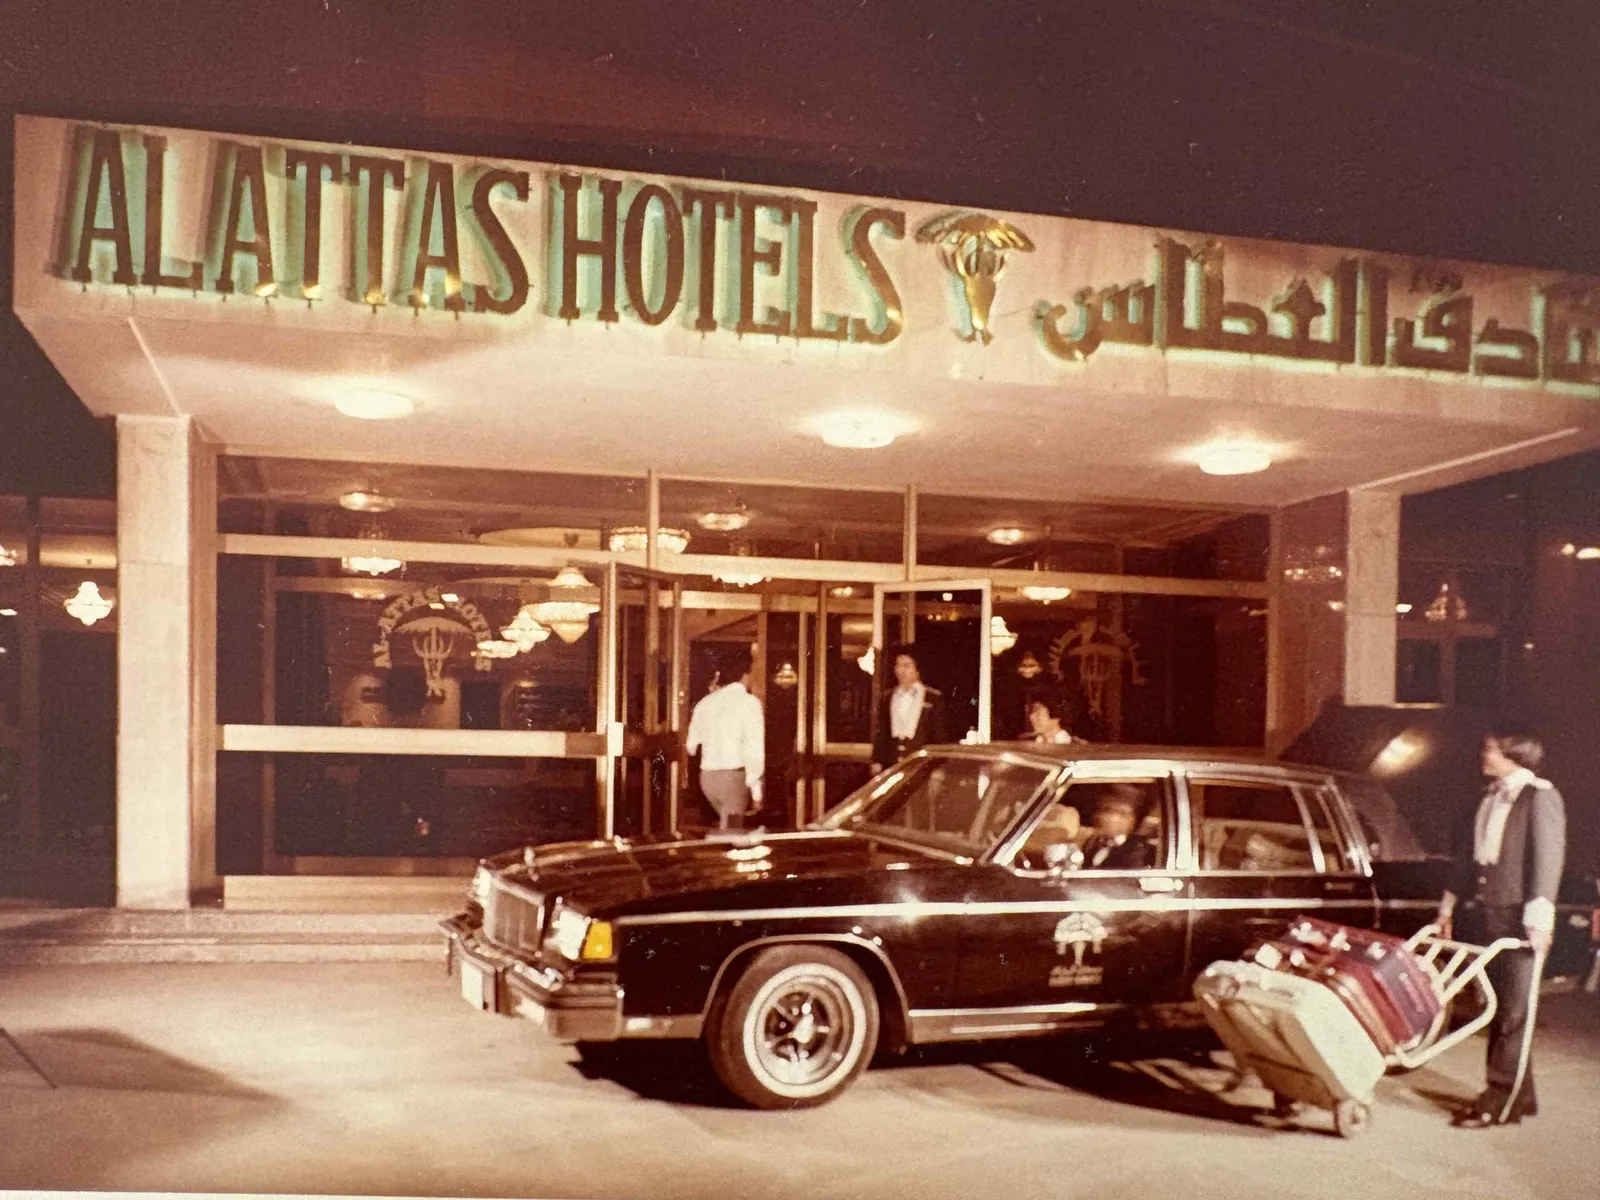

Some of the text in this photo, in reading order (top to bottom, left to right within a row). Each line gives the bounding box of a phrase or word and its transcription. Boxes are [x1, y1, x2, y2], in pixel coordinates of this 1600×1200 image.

[558, 173, 906, 345] HOTELS
[1041, 236, 1600, 384] نادق العطاس
